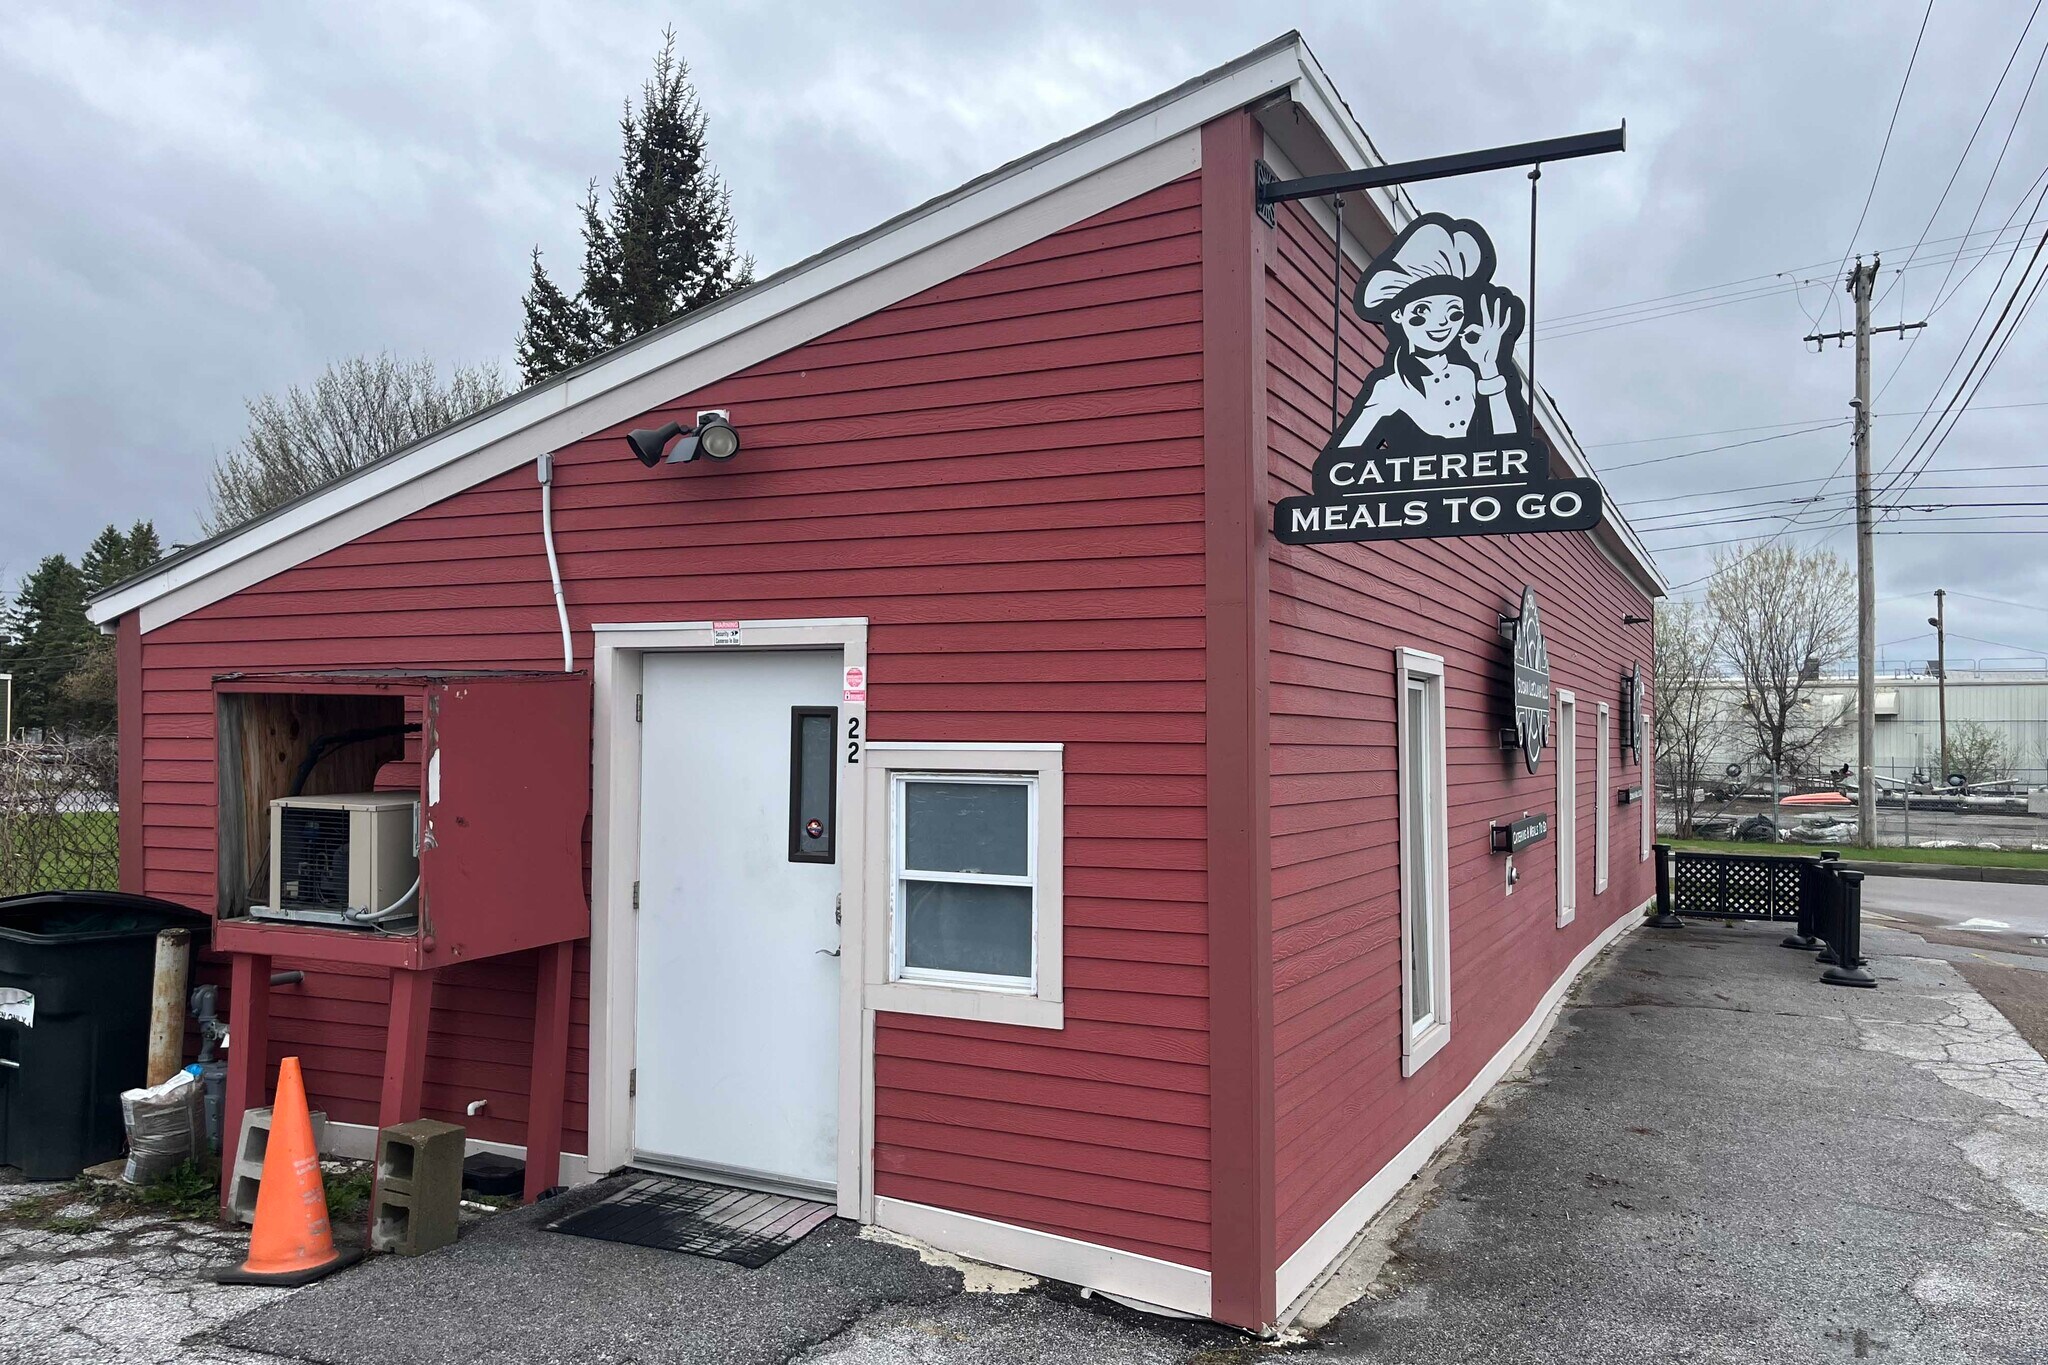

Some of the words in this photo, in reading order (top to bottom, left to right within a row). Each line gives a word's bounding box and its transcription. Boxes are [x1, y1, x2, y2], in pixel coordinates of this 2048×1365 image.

[1329, 449, 1528, 486] CATERER
[1291, 500, 1429, 532] MEALS
[1443, 496, 1501, 524] TO
[1516, 491, 1583, 519] GO
